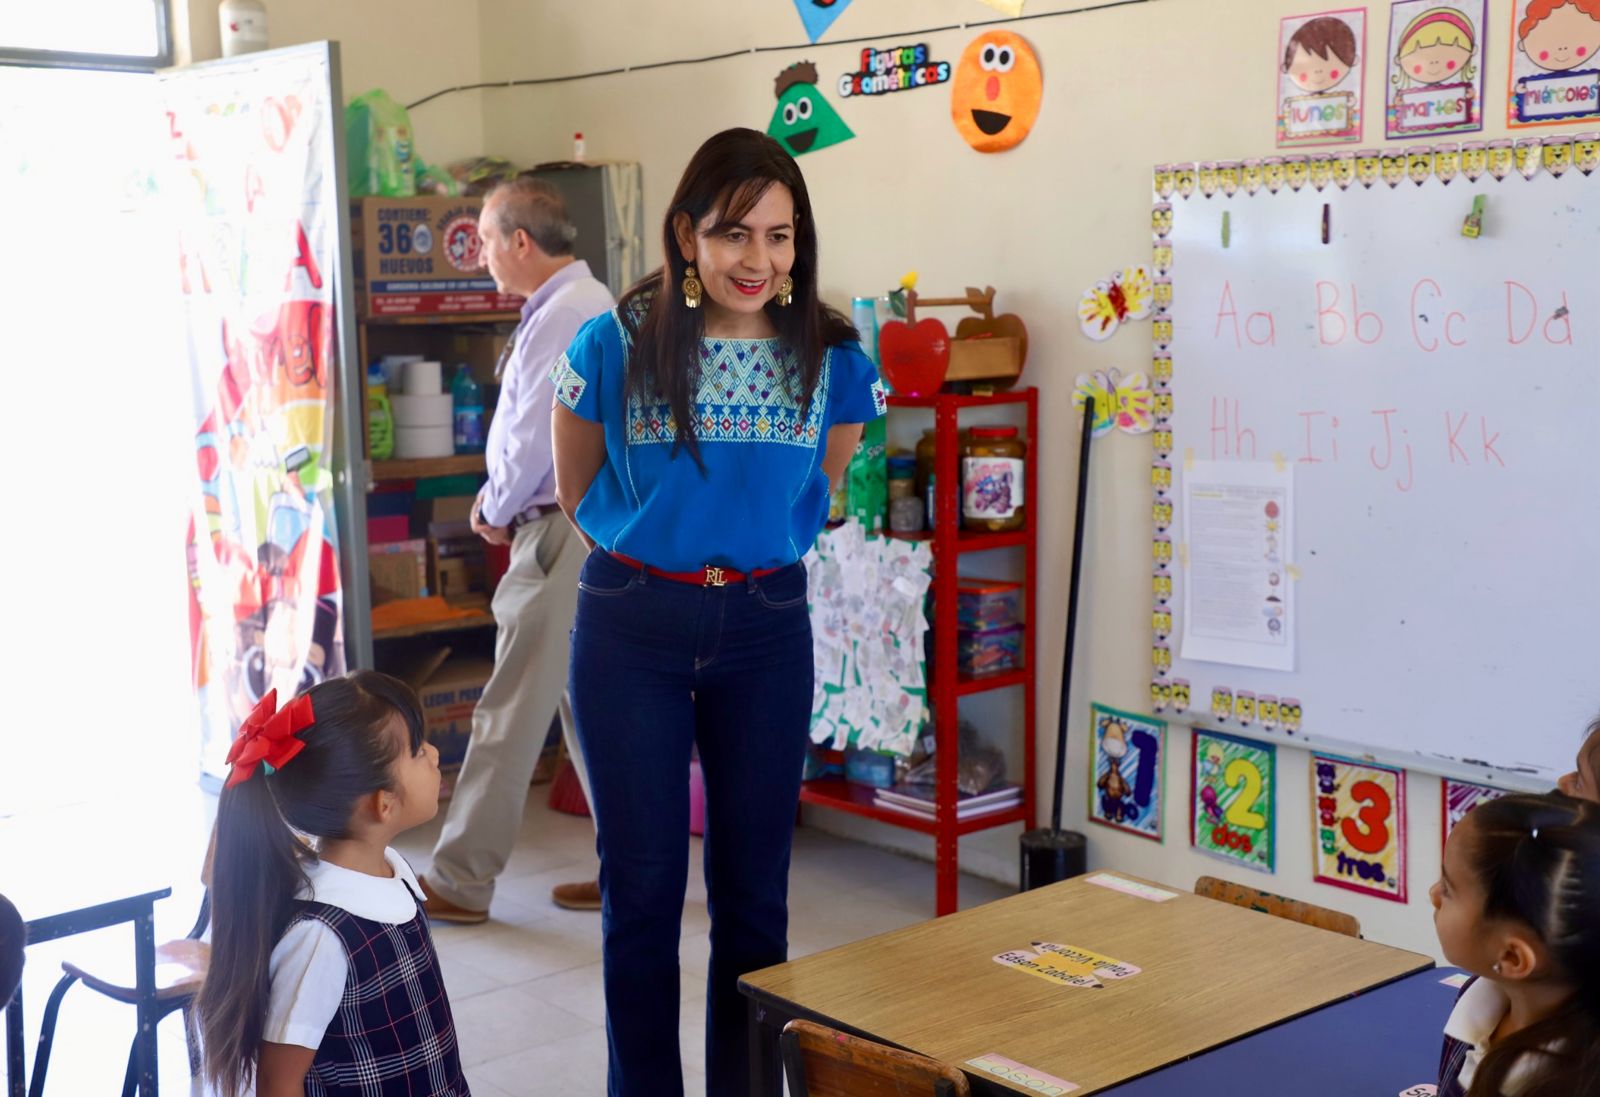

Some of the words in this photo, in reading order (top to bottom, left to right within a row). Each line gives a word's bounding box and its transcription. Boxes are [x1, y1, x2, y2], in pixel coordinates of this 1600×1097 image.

[861, 44, 928, 76] Figuras
[838, 62, 951, 97] Geométricas
[1394, 98, 1463, 119] martes
[1525, 85, 1598, 106] miércoles
[1292, 103, 1345, 123] lunes
[380, 258, 433, 275] HUEVOS
[1214, 280, 1276, 350] Aa
[1315, 281, 1383, 346] Bb
[1411, 279, 1467, 352] Cc
[1504, 280, 1573, 346] Dd
[1210, 397, 1256, 461] Hh
[1224, 758, 1266, 830] 2
[1341, 780, 1391, 854] 3
[1211, 823, 1253, 854] dos
[1336, 851, 1385, 882] tres
[1000, 952, 1039, 971] Edson
